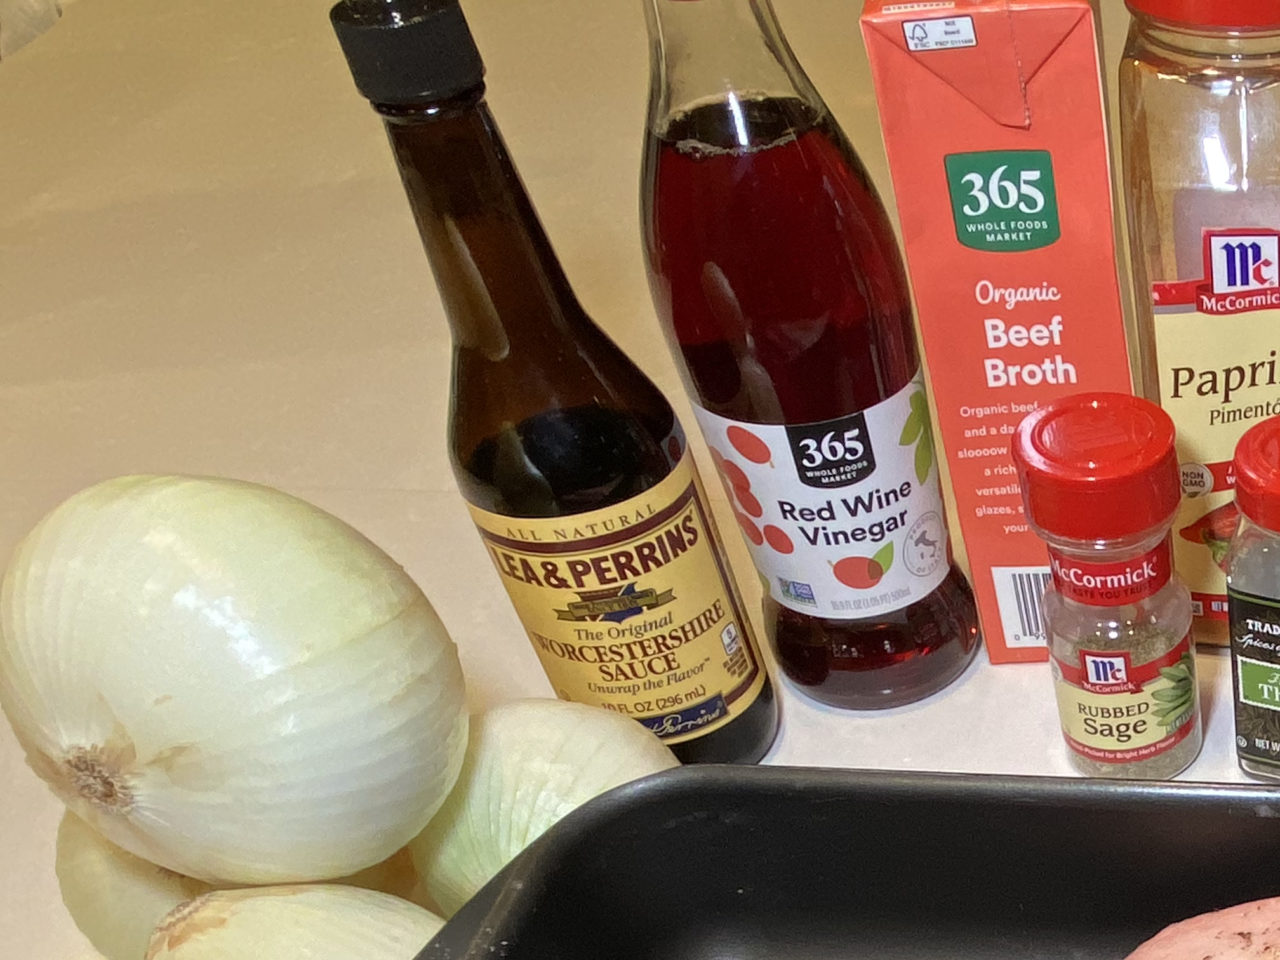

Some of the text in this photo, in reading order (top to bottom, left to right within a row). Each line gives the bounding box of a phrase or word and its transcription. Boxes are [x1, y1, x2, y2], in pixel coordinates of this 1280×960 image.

[960, 165, 1046, 217] 365
[966, 220, 1049, 233] WHOLE FOODS
[985, 231, 1033, 243] MARKET
[974, 279, 1062, 311] Organic
[983, 314, 1064, 350] Beef
[983, 354, 1078, 388] Broth
[959, 403, 1009, 418] Organic
[963, 424, 988, 439] and
[989, 427, 998, 436] a
[799, 428, 865, 468] 365
[805, 460, 869, 478] WHOLE FOODS
[821, 471, 858, 484] MARKET
[984, 463, 1017, 477] a rich
[1181, 471, 1204, 480] NON
[776, 479, 913, 523] Red Wine
[505, 502, 658, 542] ALL NATURAL
[797, 508, 909, 547] Vinegar
[573, 610, 674, 641] The Original
[1235, 633, 1276, 651] Spices
[598, 651, 681, 683] SAUCE
[587, 681, 641, 697] Unwrap
[643, 678, 664, 692] the
[1081, 680, 1137, 693] McCormick
[618, 703, 634, 714] FL
[634, 701, 655, 713] OZ
[655, 695, 684, 711] (296
[685, 683, 707, 703] mL)
[1077, 701, 1151, 719] RUBBED
[1083, 717, 1148, 744] Sage
[1254, 737, 1270, 750] NET
